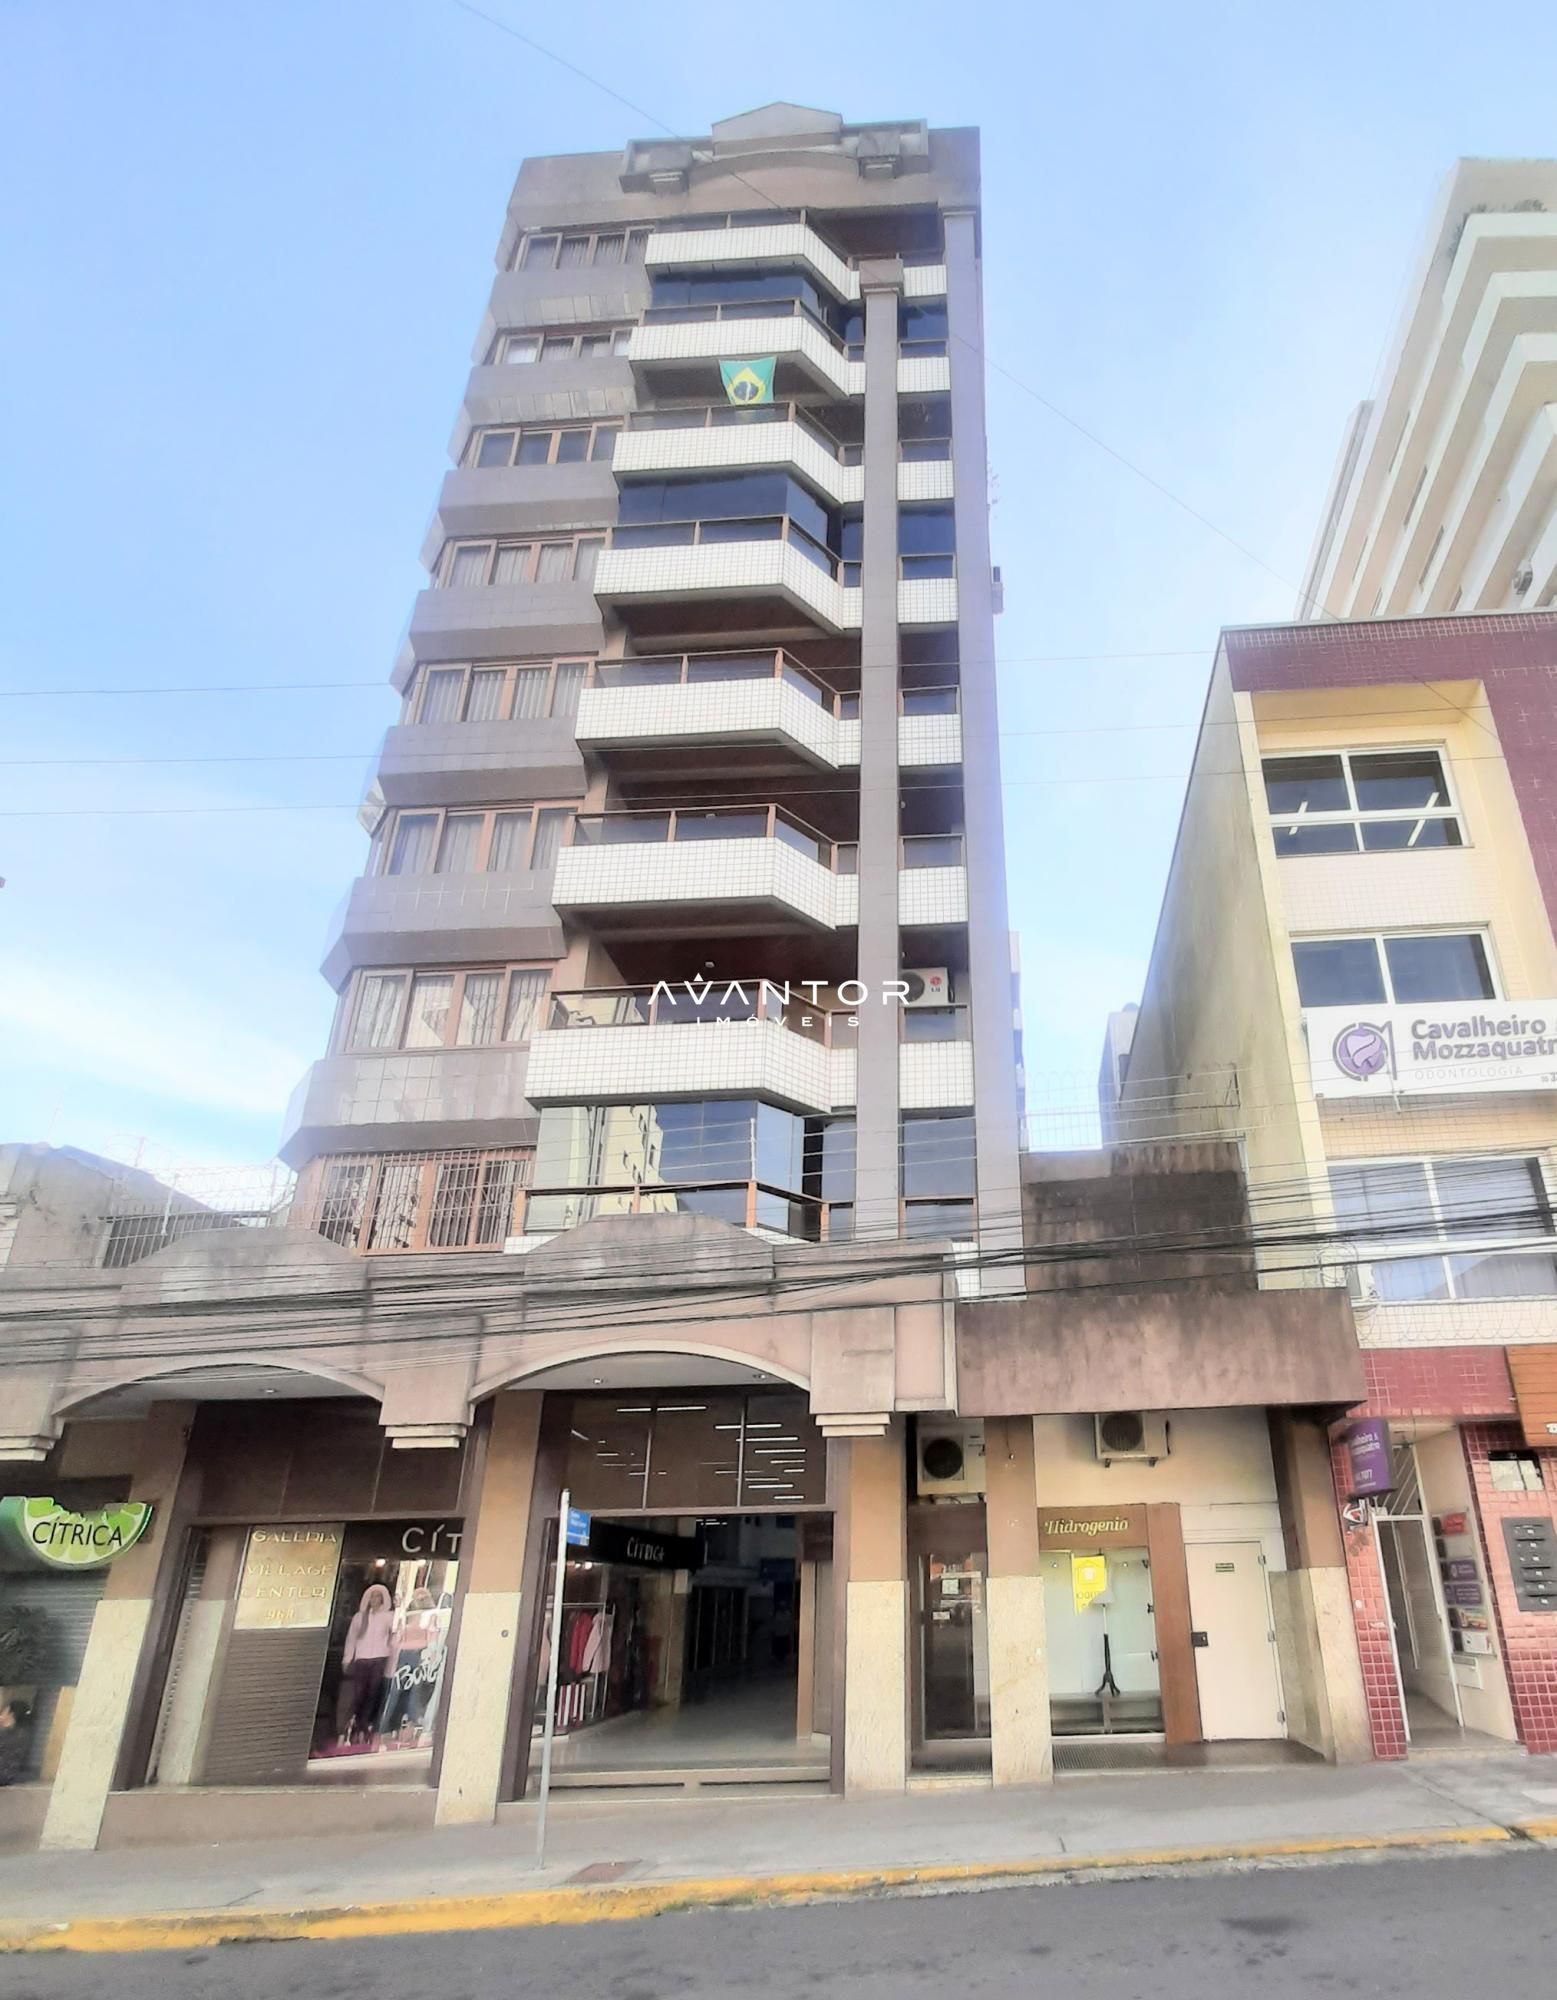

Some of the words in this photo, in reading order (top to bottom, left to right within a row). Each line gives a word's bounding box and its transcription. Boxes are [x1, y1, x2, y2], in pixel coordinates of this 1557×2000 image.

[1411, 1014, 1547, 1040] Cavalheiro
[32, 1516, 123, 1547] CÍTRICA
[402, 1524, 463, 1554] CÍT
